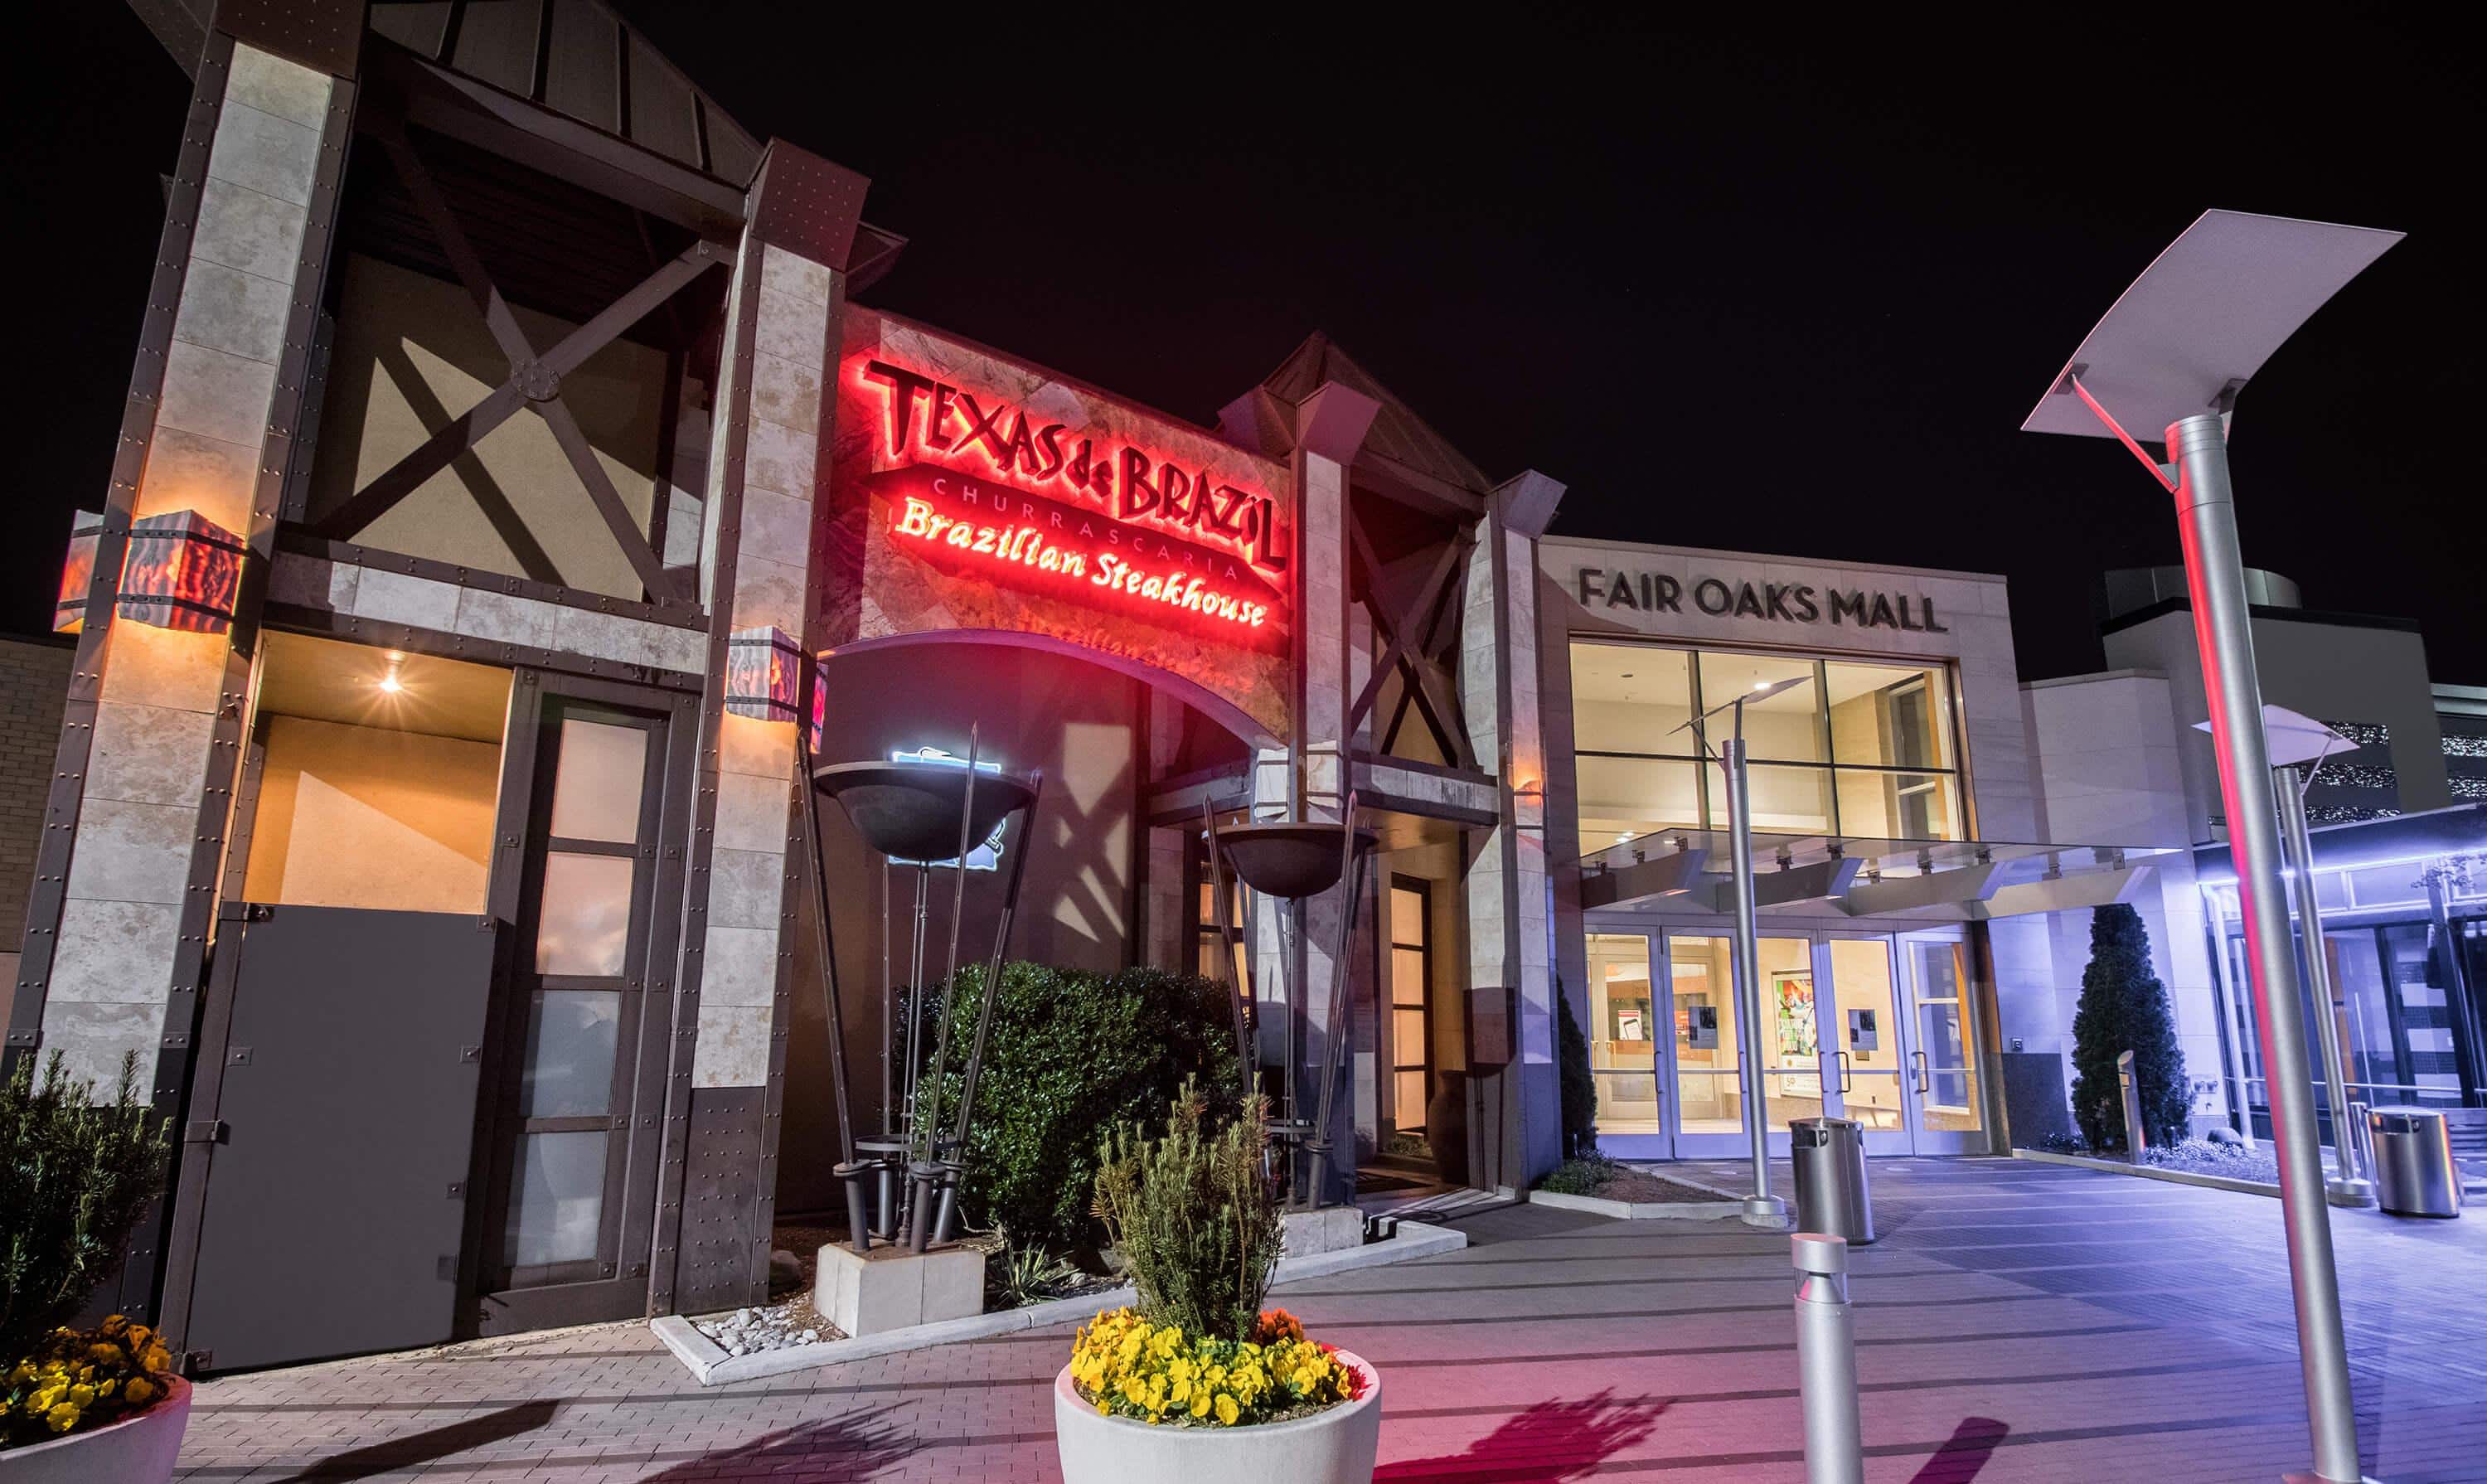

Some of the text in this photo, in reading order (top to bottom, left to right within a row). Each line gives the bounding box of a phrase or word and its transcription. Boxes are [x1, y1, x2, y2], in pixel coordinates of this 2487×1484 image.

[863, 359, 1066, 480] TEXAS
[1119, 446, 1287, 575] BRAZIL
[896, 497, 1268, 628] Brazilian Steakhouse
[933, 478, 1238, 580] CHURRASCARIA
[1578, 569, 1947, 633] FAIR OAKS MALL
